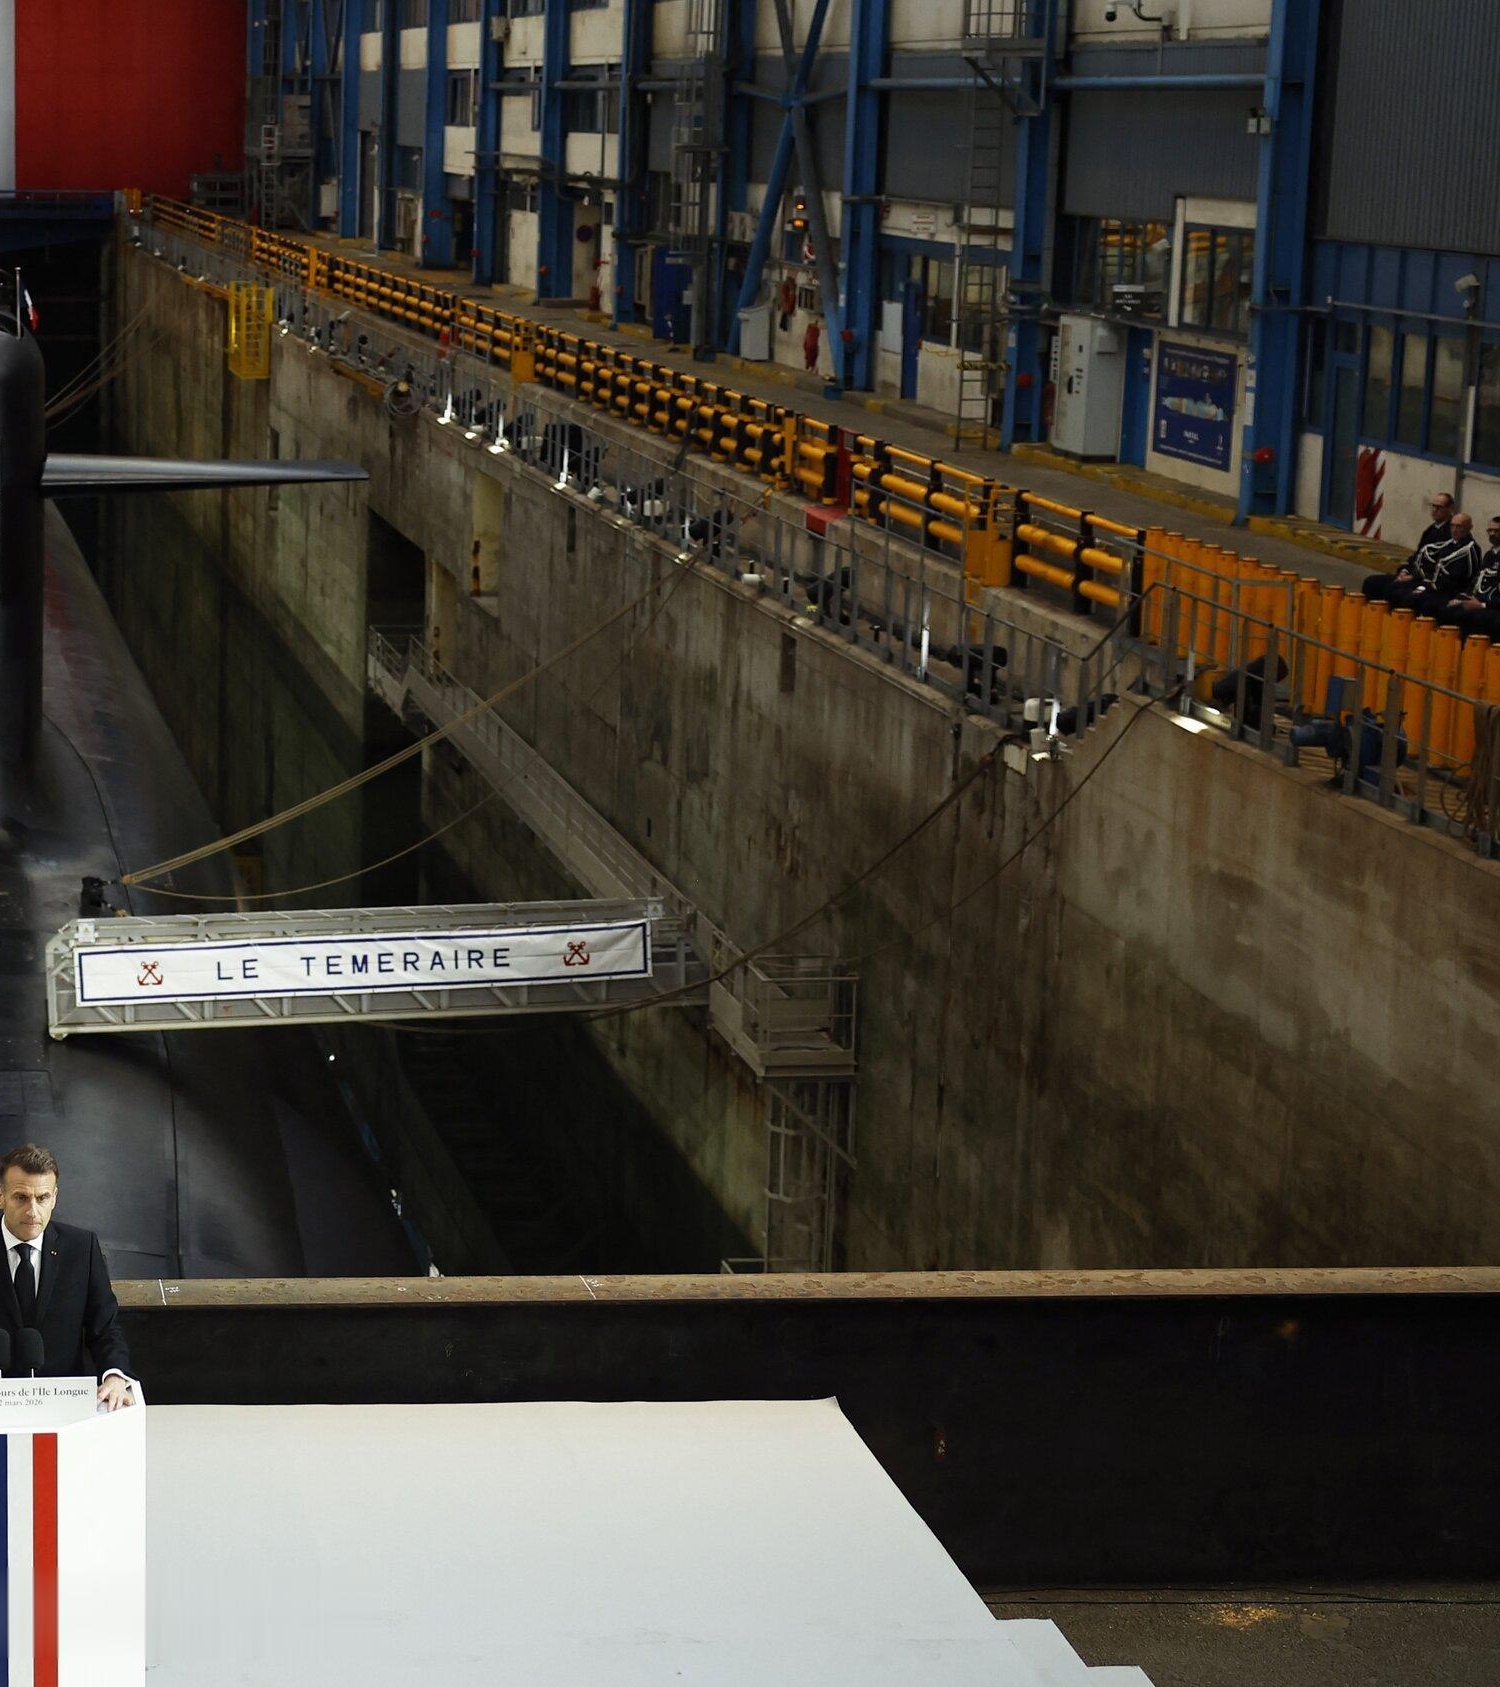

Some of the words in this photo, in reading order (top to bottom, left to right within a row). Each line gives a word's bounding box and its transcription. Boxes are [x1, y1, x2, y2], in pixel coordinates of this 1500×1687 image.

[216, 958, 259, 981] LE
[299, 947, 511, 976] TEMERAIRE
[18, 1387, 30, 1397] de
[53, 1387, 89, 1398] Longue
[24, 1398, 44, 1407] 2026
